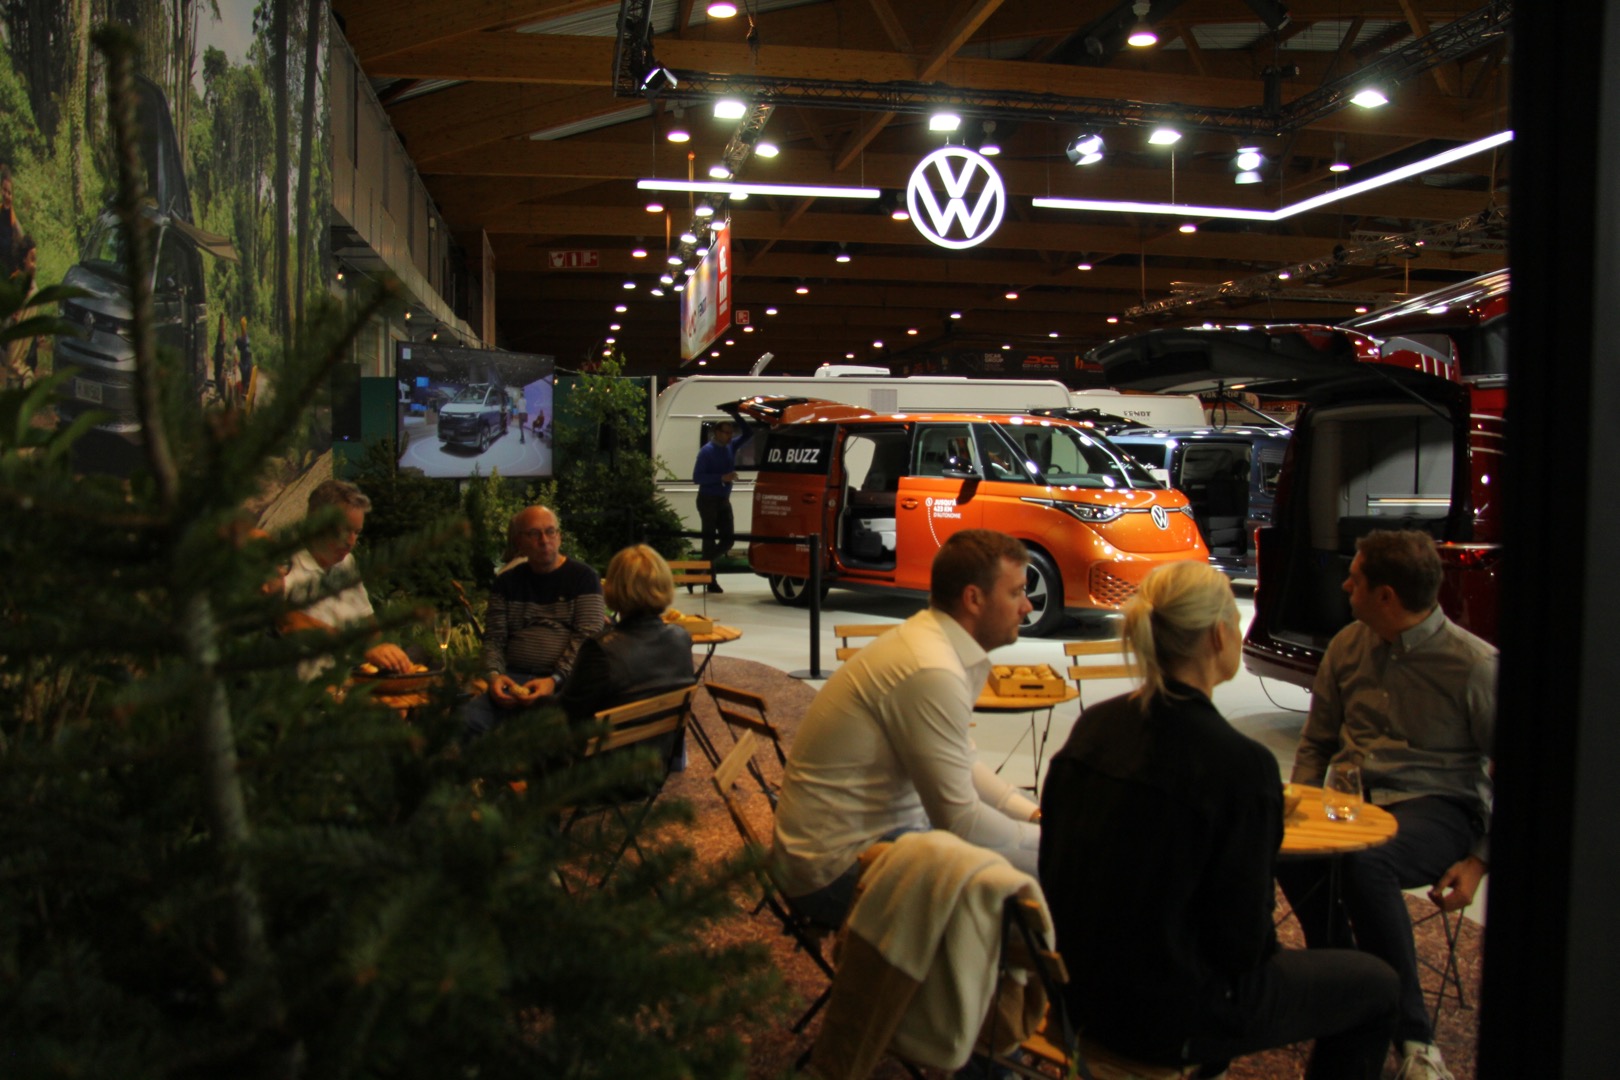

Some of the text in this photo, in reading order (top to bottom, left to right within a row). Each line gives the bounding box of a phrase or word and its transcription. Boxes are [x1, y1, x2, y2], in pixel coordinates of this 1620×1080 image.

[906, 147, 1006, 250] VW
[768, 448, 820, 464] ID. BUZZ
